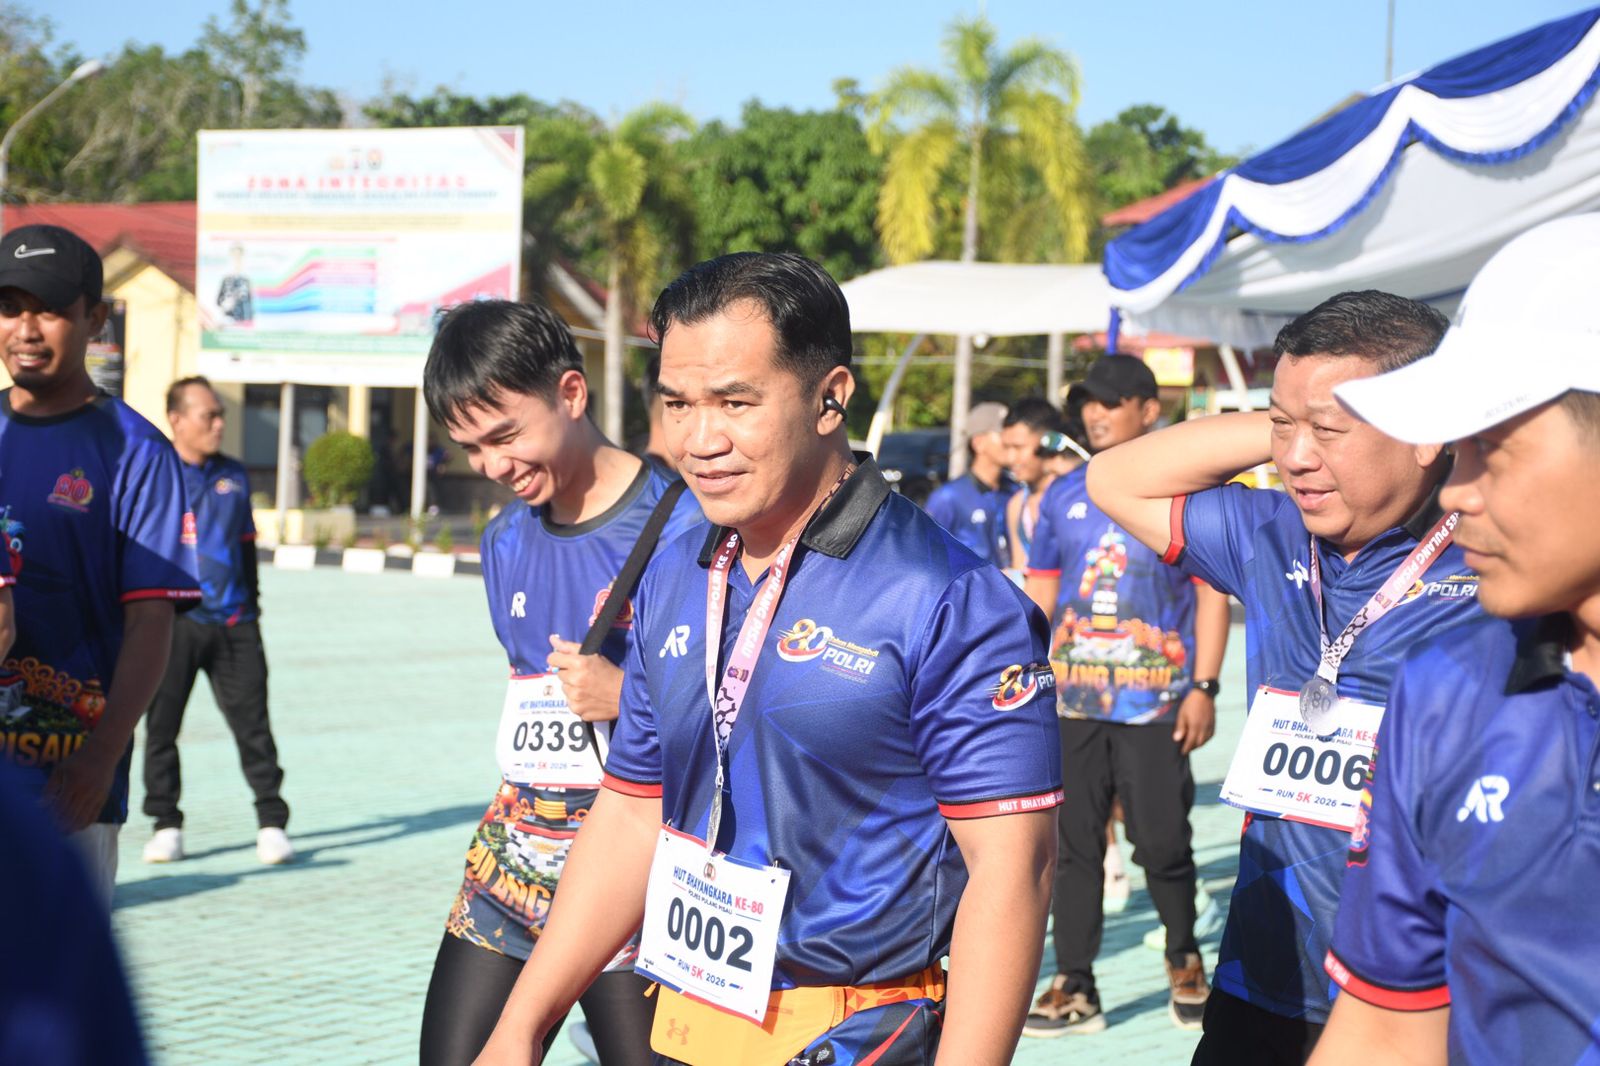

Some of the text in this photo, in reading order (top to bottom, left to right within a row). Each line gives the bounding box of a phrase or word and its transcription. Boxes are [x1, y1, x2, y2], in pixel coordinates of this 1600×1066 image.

[715, 555, 729, 569] KE
[726, 533, 738, 549] 80
[1415, 527, 1450, 566] PULANG
[1427, 583, 1479, 597] POLRI
[822, 647, 876, 675] POLRI
[513, 720, 590, 752] 0339
[1272, 718, 1291, 730] HUT
[1291, 720, 1354, 739] BHAARA
[1263, 742, 1370, 791] 0006
[998, 801, 1019, 812] HUT
[1276, 789, 1337, 808] RUN 5K 2026
[673, 865, 764, 915] HUT BHAYANGKARA KE-80
[667, 896, 754, 972] 0002
[677, 959, 726, 988] RUN 5K 2026
